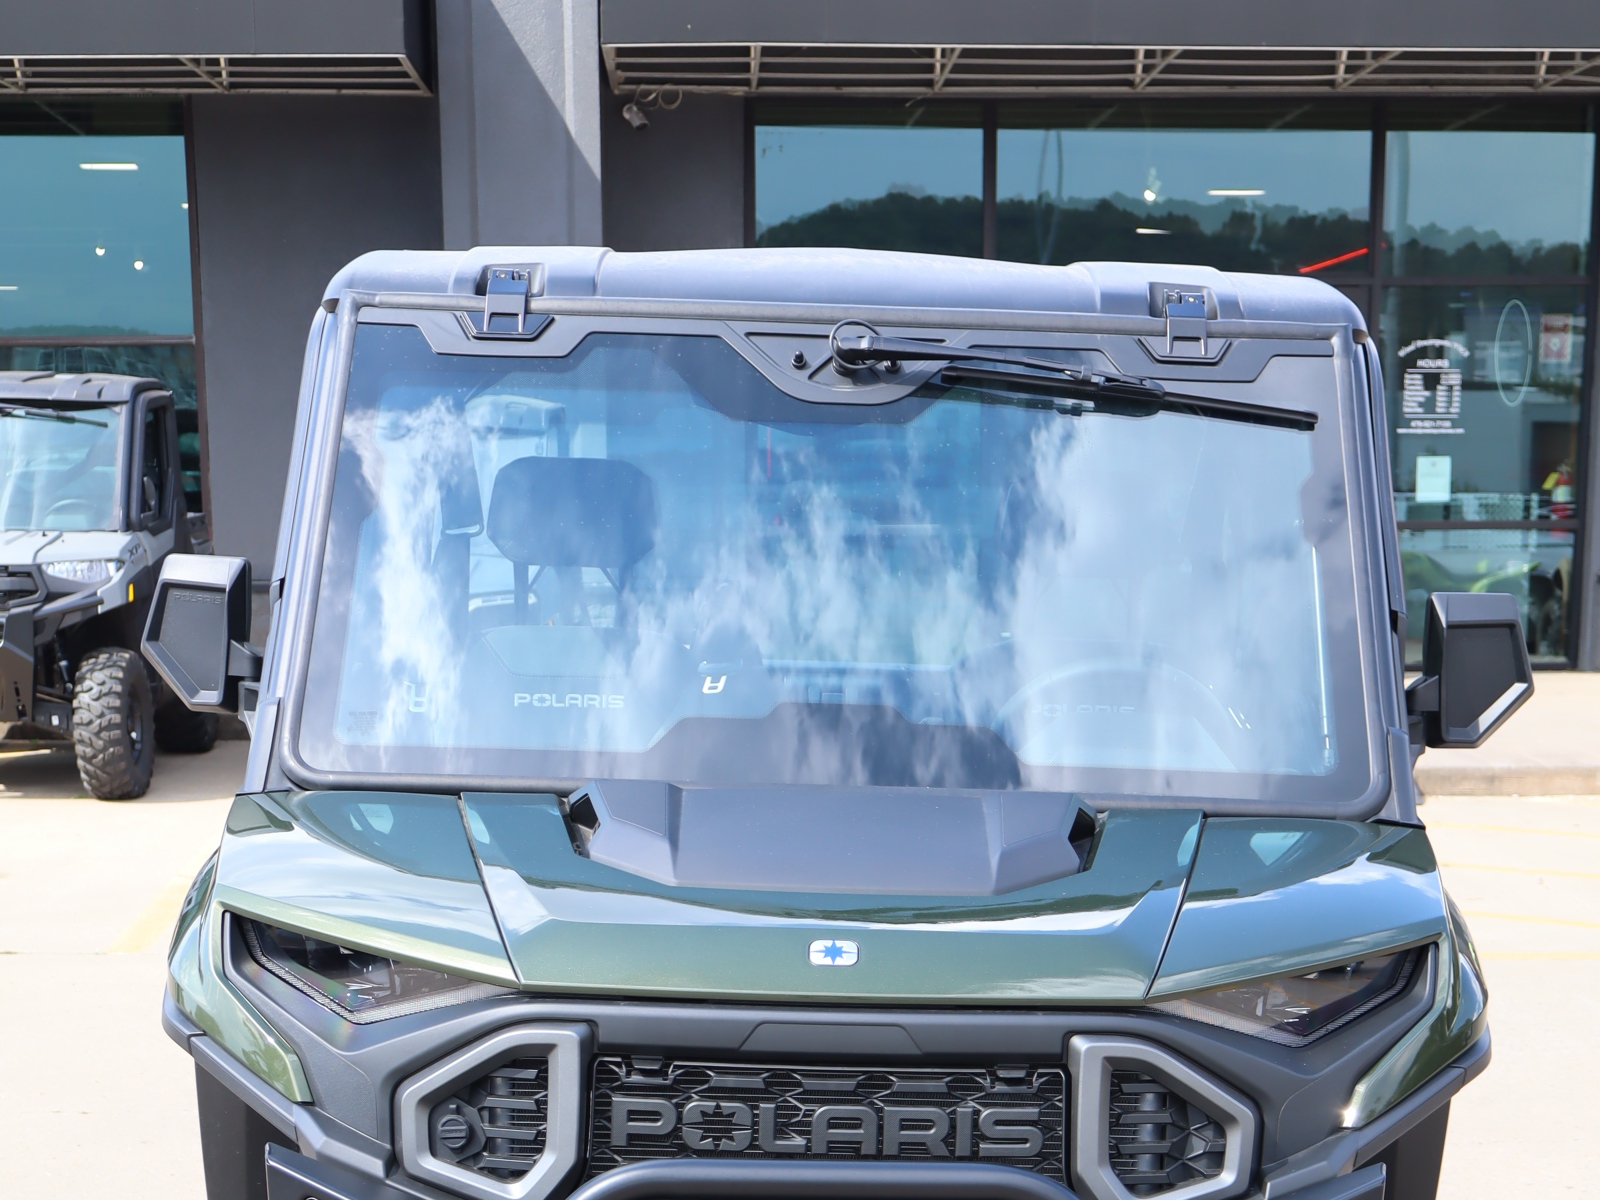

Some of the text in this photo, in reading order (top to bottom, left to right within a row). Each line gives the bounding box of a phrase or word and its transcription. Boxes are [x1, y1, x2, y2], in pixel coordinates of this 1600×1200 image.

[128, 543, 141, 558] XP
[173, 592, 223, 605] POLARIS
[514, 692, 625, 709] POLARIS
[610, 1095, 1045, 1158] POLARIS
